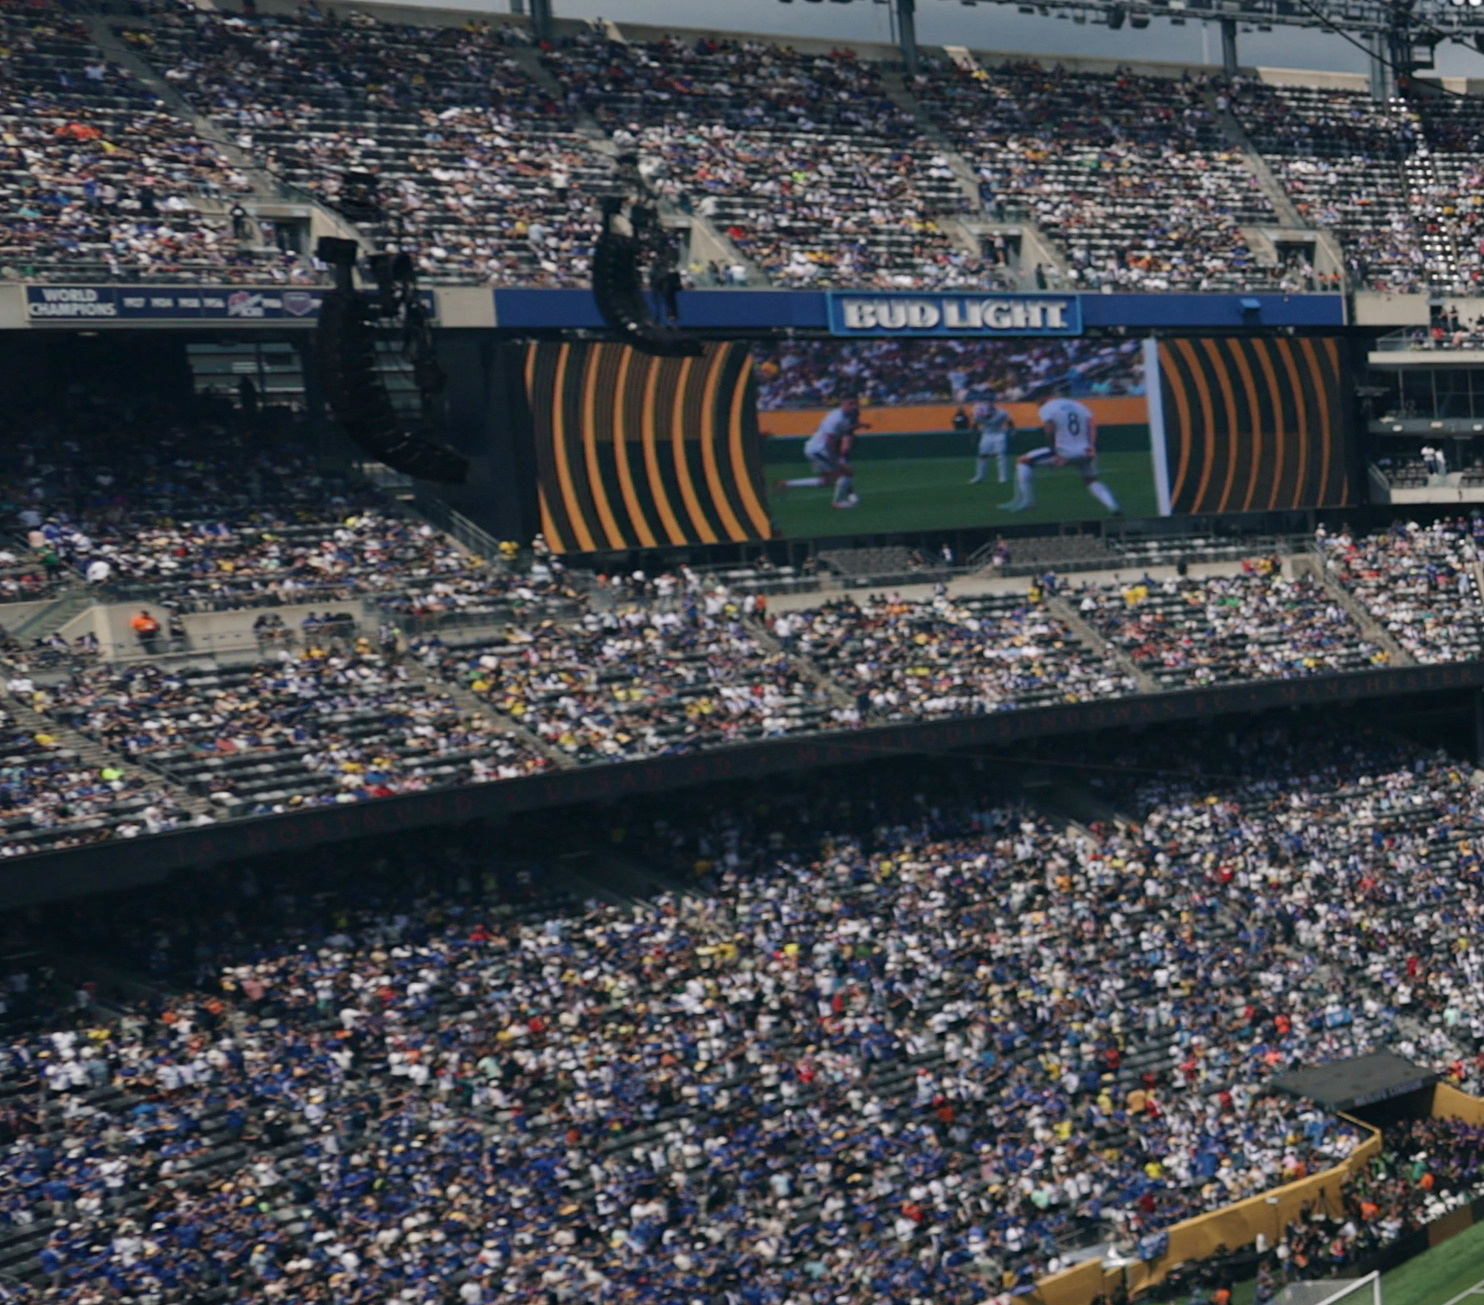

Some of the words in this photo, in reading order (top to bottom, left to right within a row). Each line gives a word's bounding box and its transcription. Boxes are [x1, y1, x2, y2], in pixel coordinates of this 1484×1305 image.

[42, 289, 98, 302] WORLD
[30, 303, 117, 316] CHAMPIONS
[843, 300, 939, 329] BUD
[942, 300, 1068, 329] LIGHT
